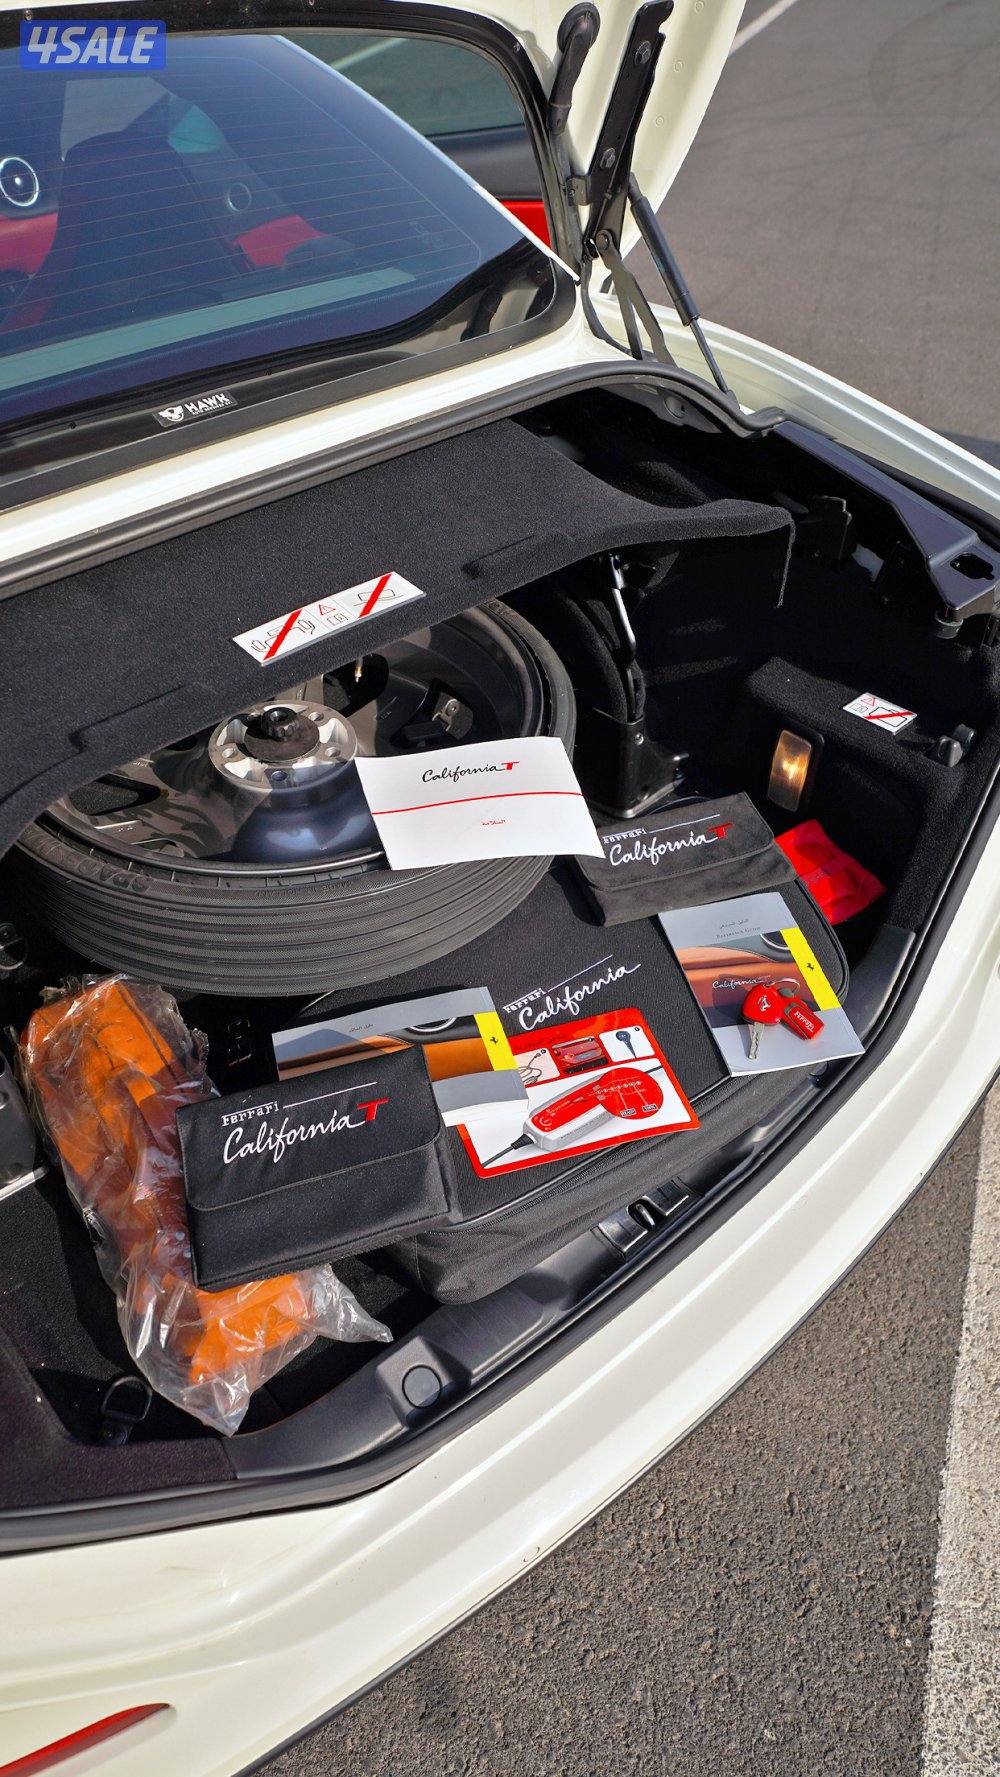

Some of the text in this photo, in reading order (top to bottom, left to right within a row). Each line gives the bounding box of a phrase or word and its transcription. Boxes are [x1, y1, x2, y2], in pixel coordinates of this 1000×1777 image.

[184, 393, 230, 413] HAWK
[422, 764, 504, 782] California
[602, 828, 647, 844] Ferrari
[609, 831, 718, 866] California
[503, 988, 547, 1014] Ferrari
[518, 963, 642, 1031] California
[794, 1010, 815, 1034] Ferrari
[221, 1100, 280, 1127] Ferrari
[223, 1097, 390, 1165] California T
